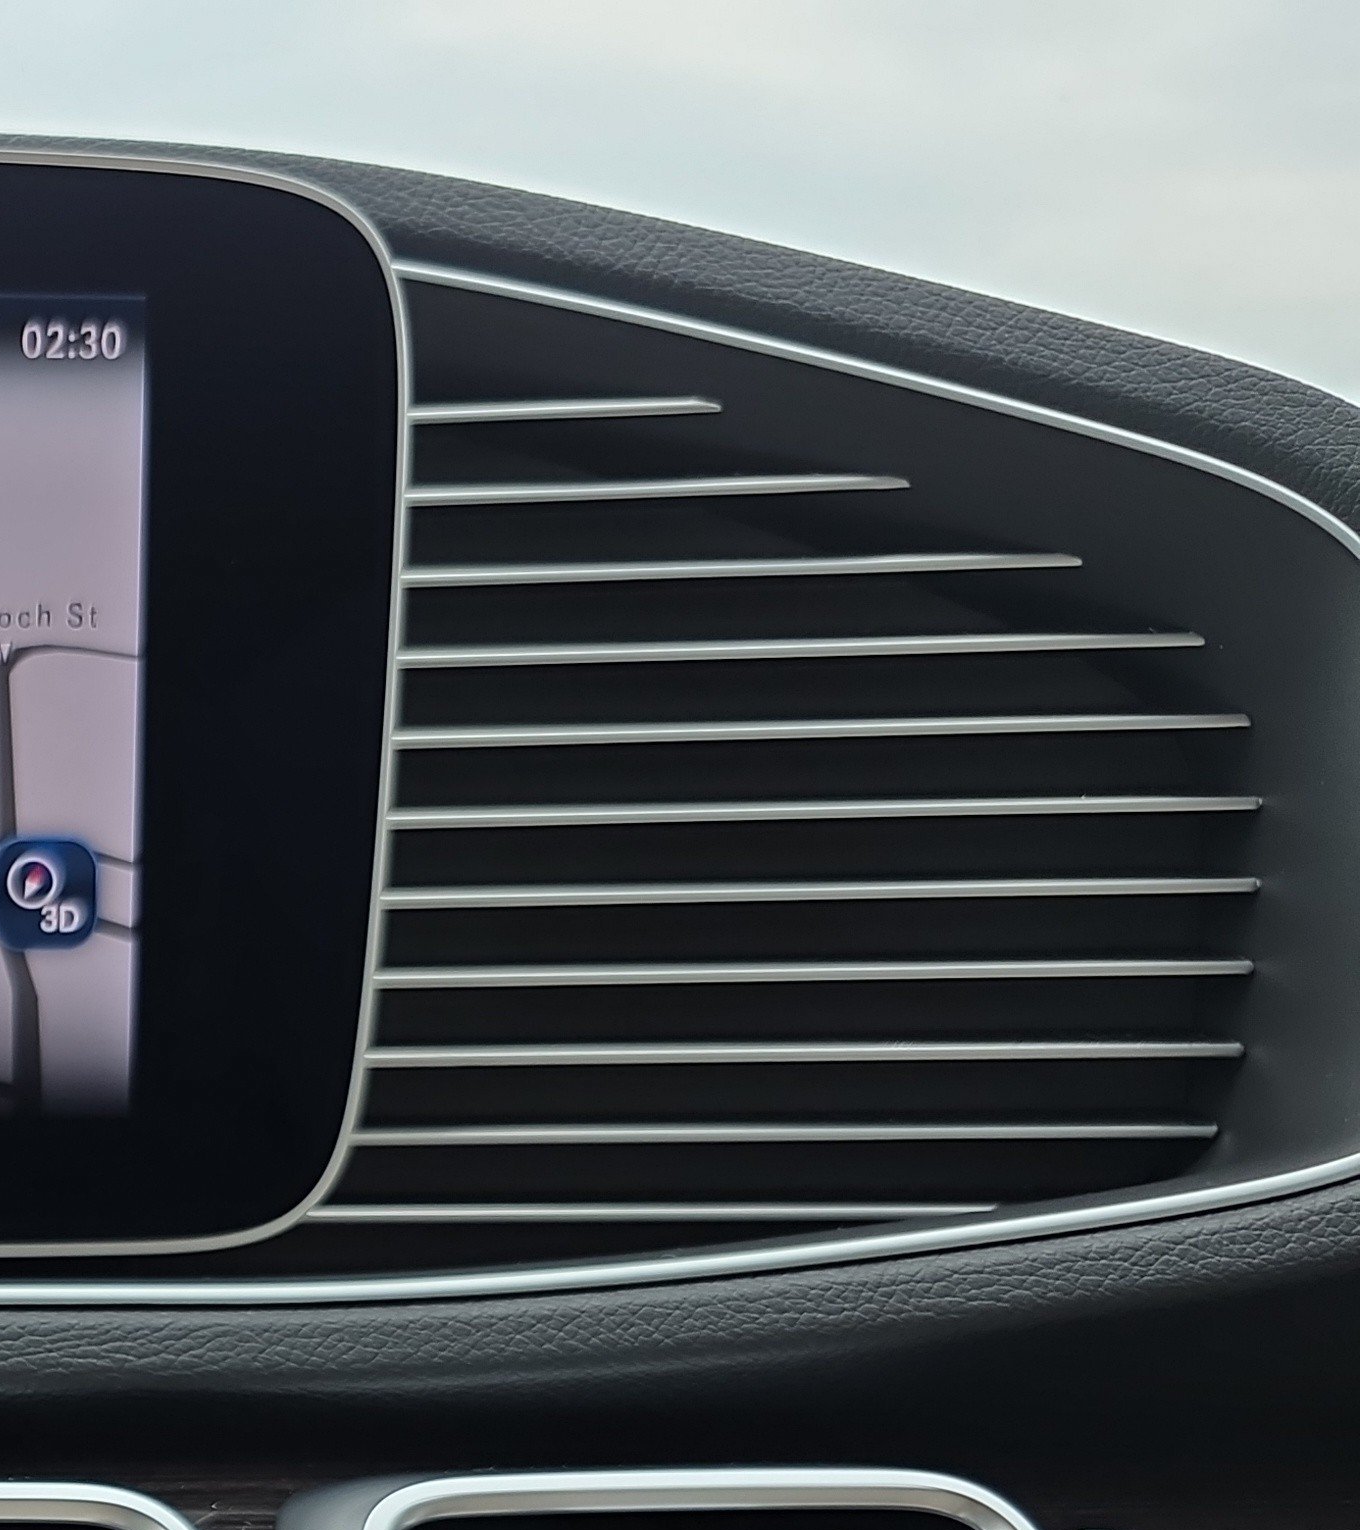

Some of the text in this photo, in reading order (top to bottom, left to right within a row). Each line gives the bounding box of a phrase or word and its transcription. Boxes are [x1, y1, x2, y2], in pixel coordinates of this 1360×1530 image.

[20, 321, 123, 361] 02:30
[66, 602, 99, 630] St
[39, 904, 81, 934] 3D
